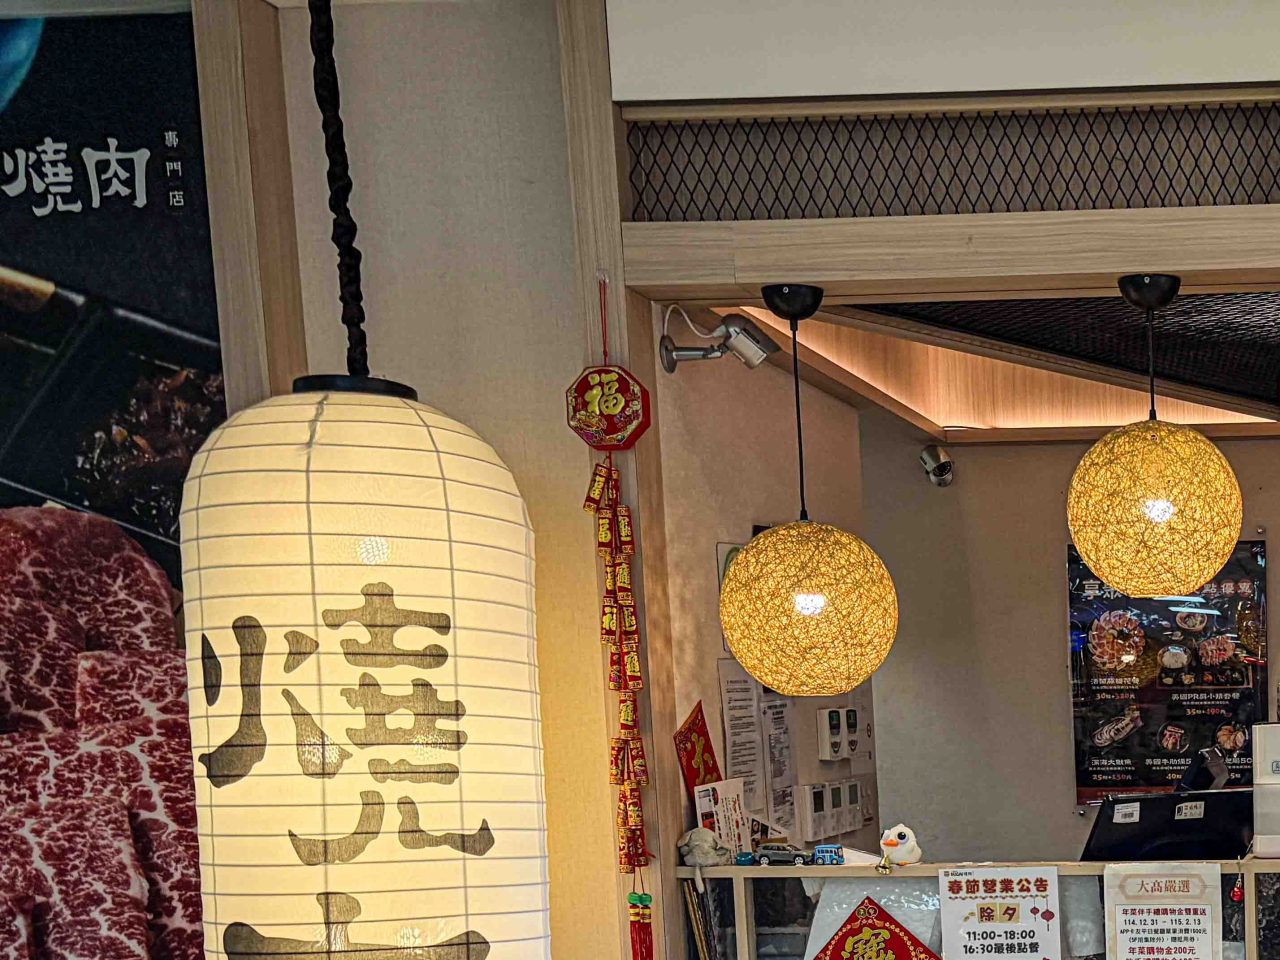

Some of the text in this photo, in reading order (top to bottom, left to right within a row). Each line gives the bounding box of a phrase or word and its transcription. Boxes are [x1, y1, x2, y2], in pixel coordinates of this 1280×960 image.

[1, 137, 151, 217] 燒肉
[163, 131, 184, 206] 專門店
[584, 372, 625, 415] 福
[947, 877, 1049, 895] 春節營業公告
[979, 906, 1017, 922] 除夕
[966, 930, 1036, 941] 11:00-18:00
[963, 942, 1040, 955] 16:30最後點餐
